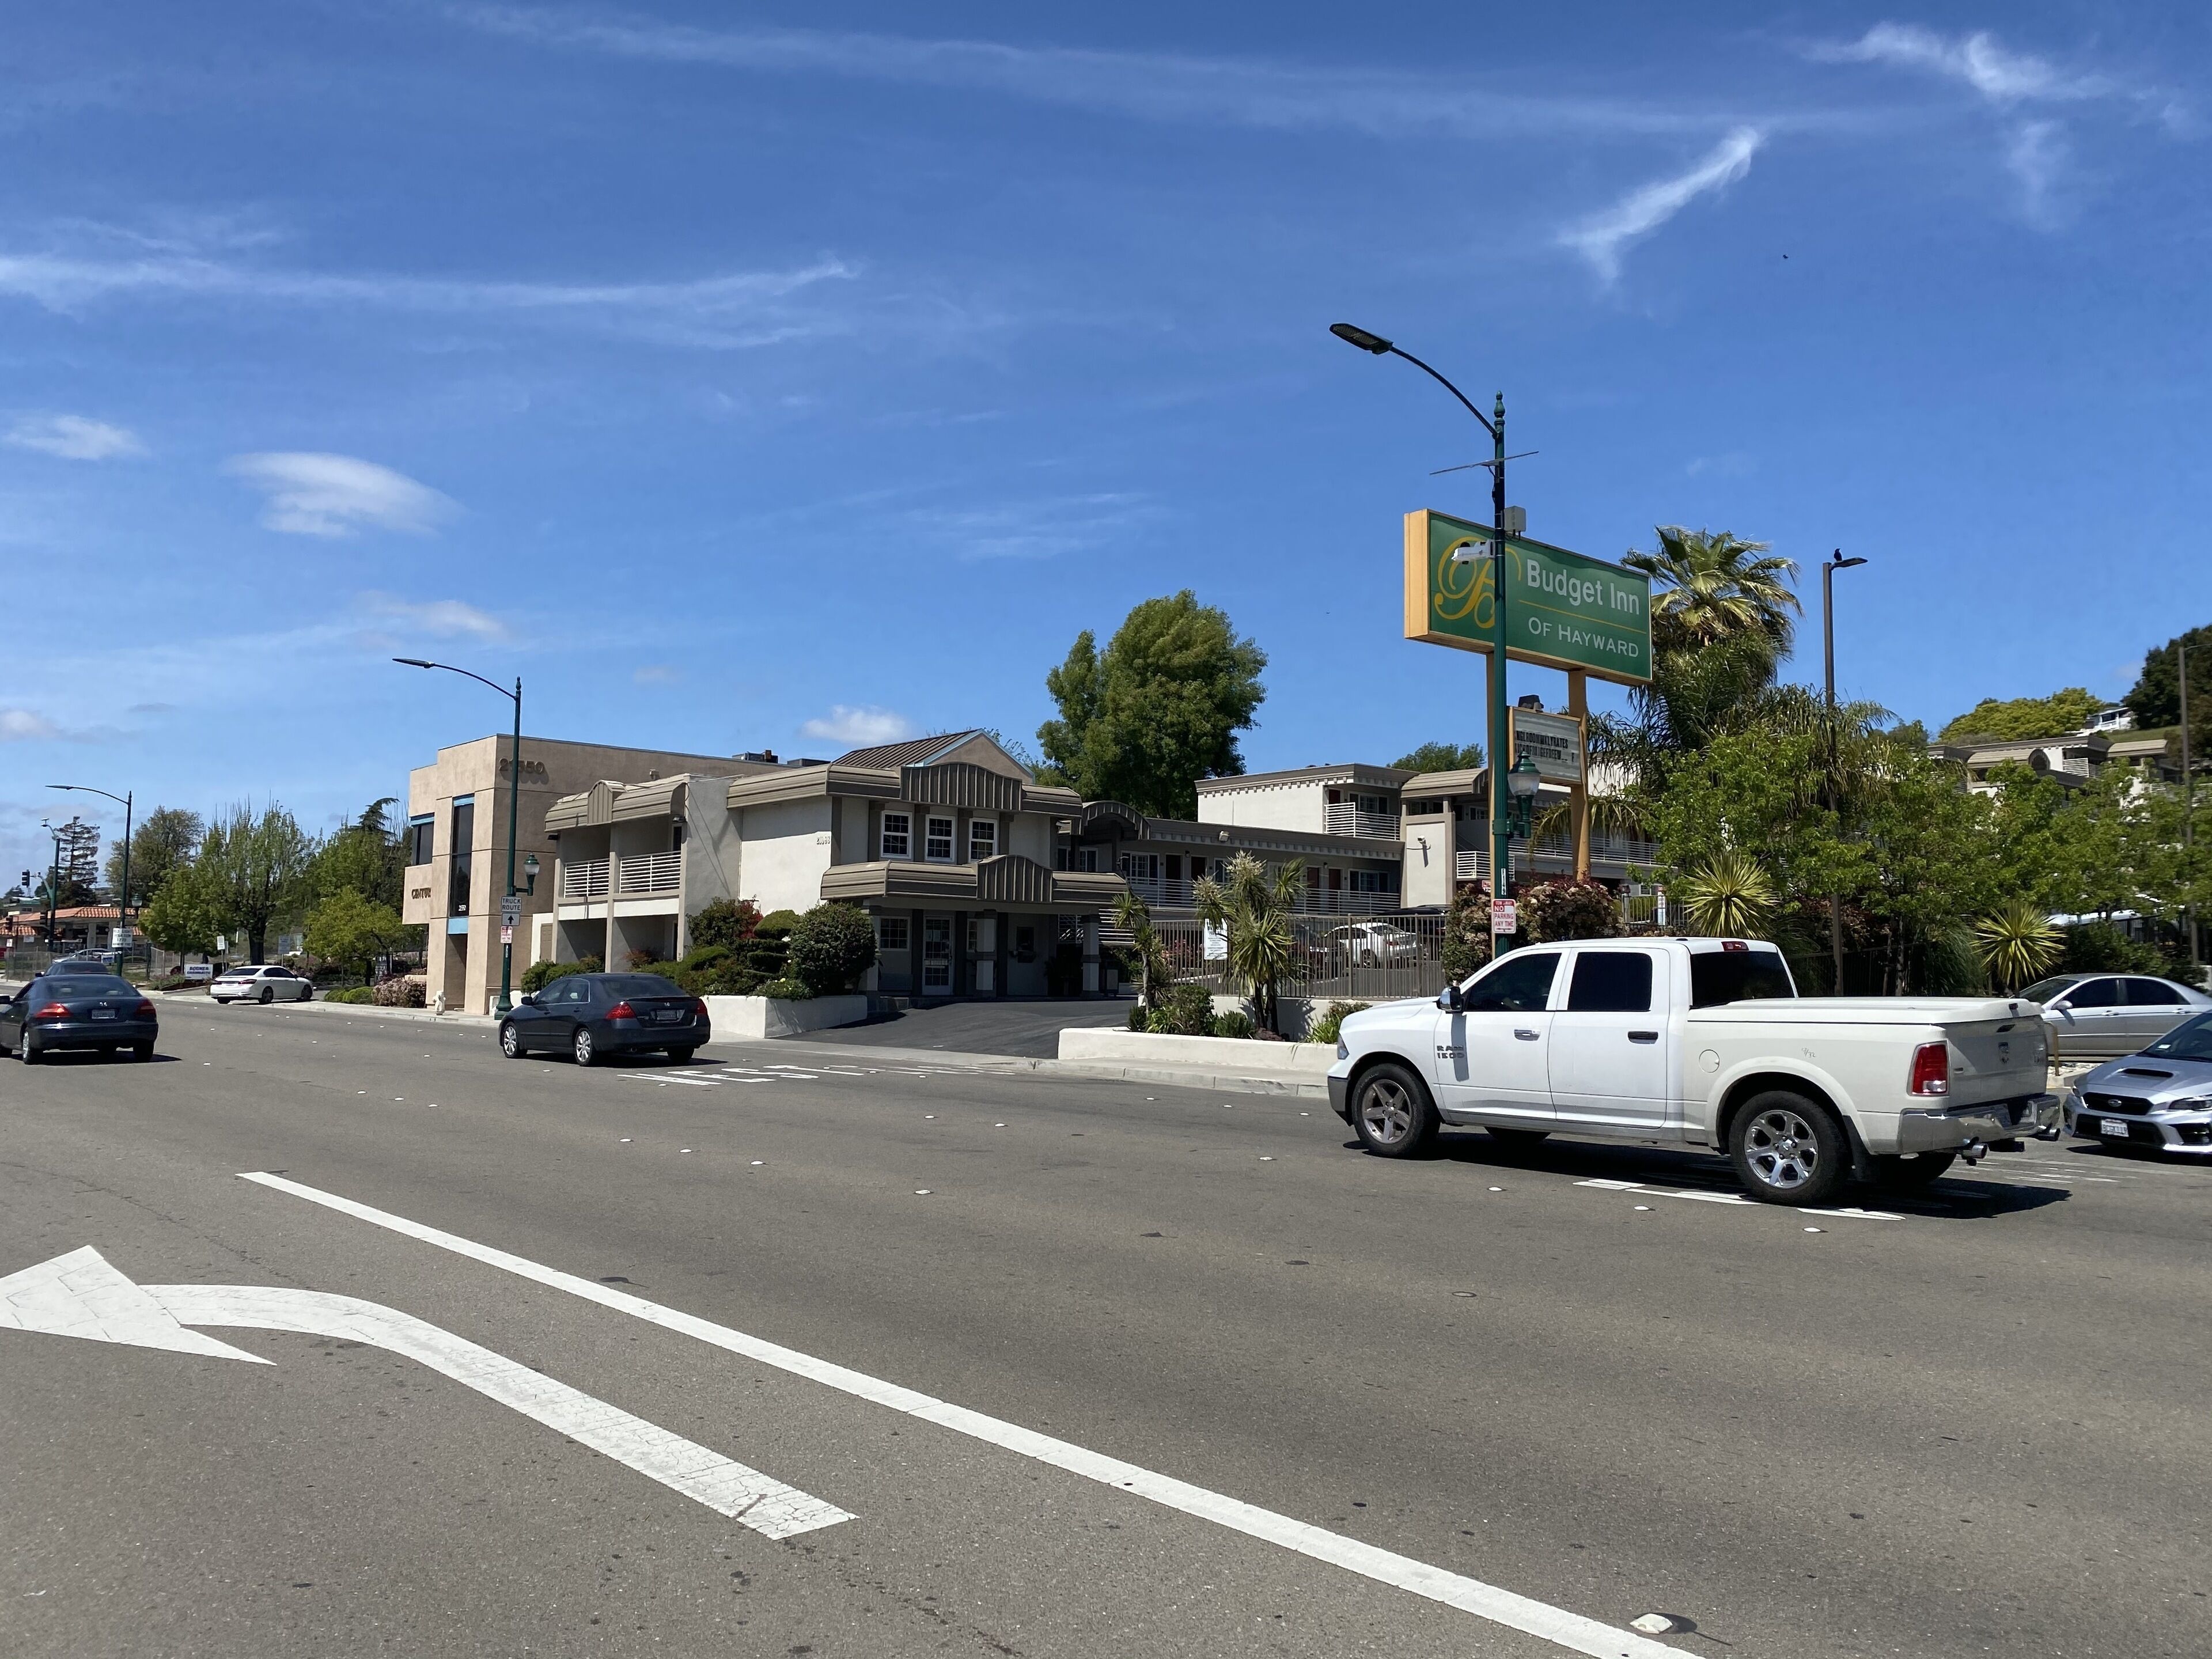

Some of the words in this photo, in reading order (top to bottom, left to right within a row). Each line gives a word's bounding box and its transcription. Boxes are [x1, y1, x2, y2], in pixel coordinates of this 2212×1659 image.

[1527, 559, 1603, 607] Budget
[1611, 582, 1639, 615] Inn
[1528, 617, 1552, 637] OF
[1558, 624, 1639, 658] HAYWARD
[499, 758, 544, 774] 2550
